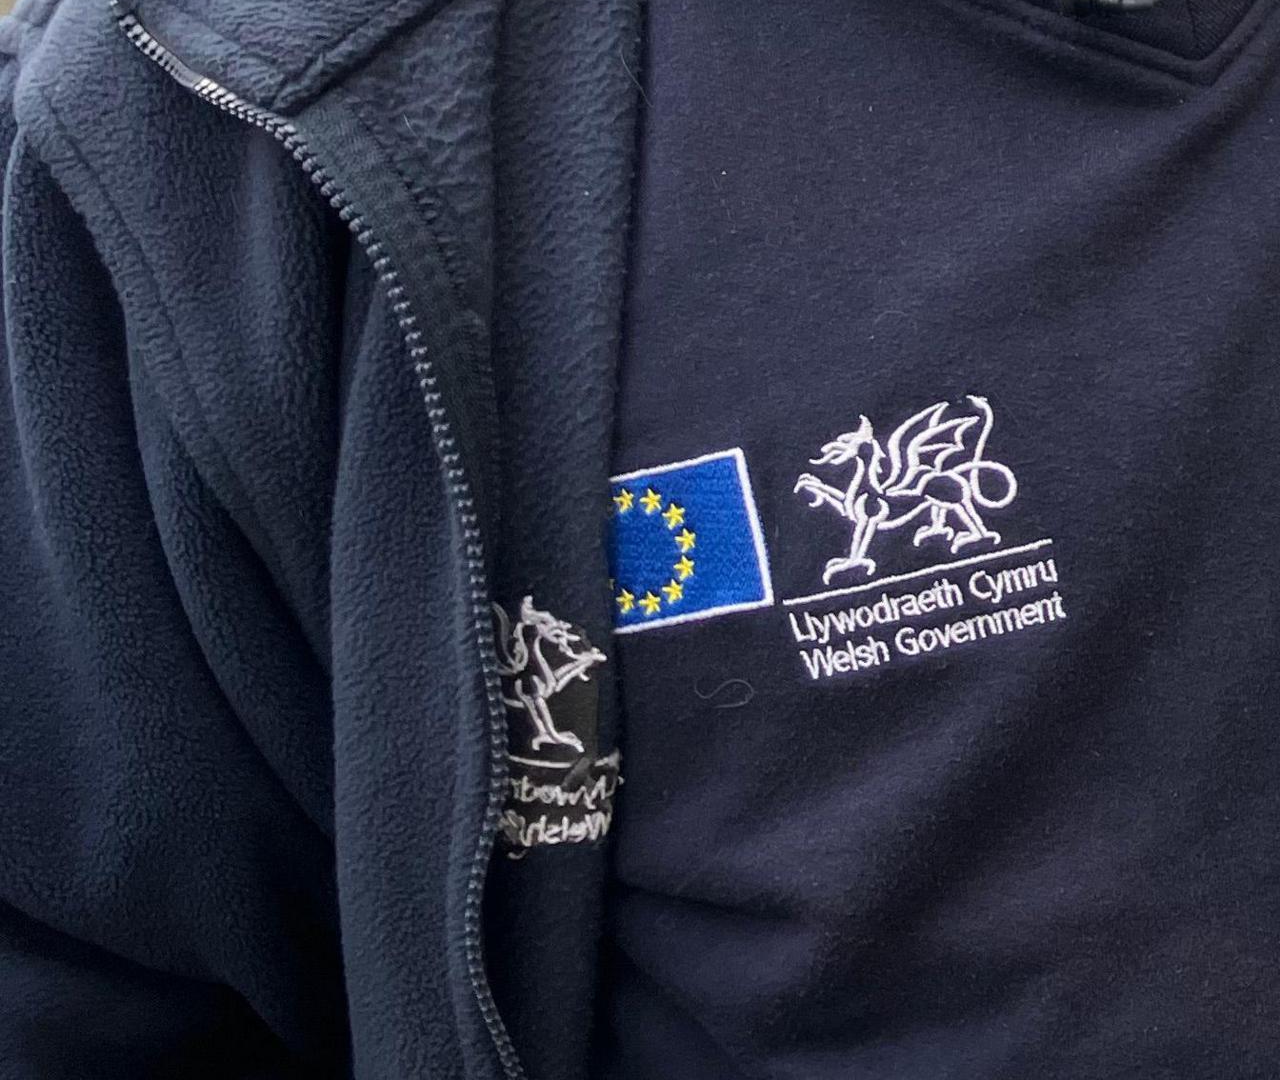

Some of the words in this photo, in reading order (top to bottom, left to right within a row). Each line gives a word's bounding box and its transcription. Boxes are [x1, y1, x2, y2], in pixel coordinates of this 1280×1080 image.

[789, 578, 963, 643] Llywodraeth
[969, 559, 1058, 603] Cymru
[800, 636, 890, 679] Welsh
[895, 591, 1066, 655] Government
